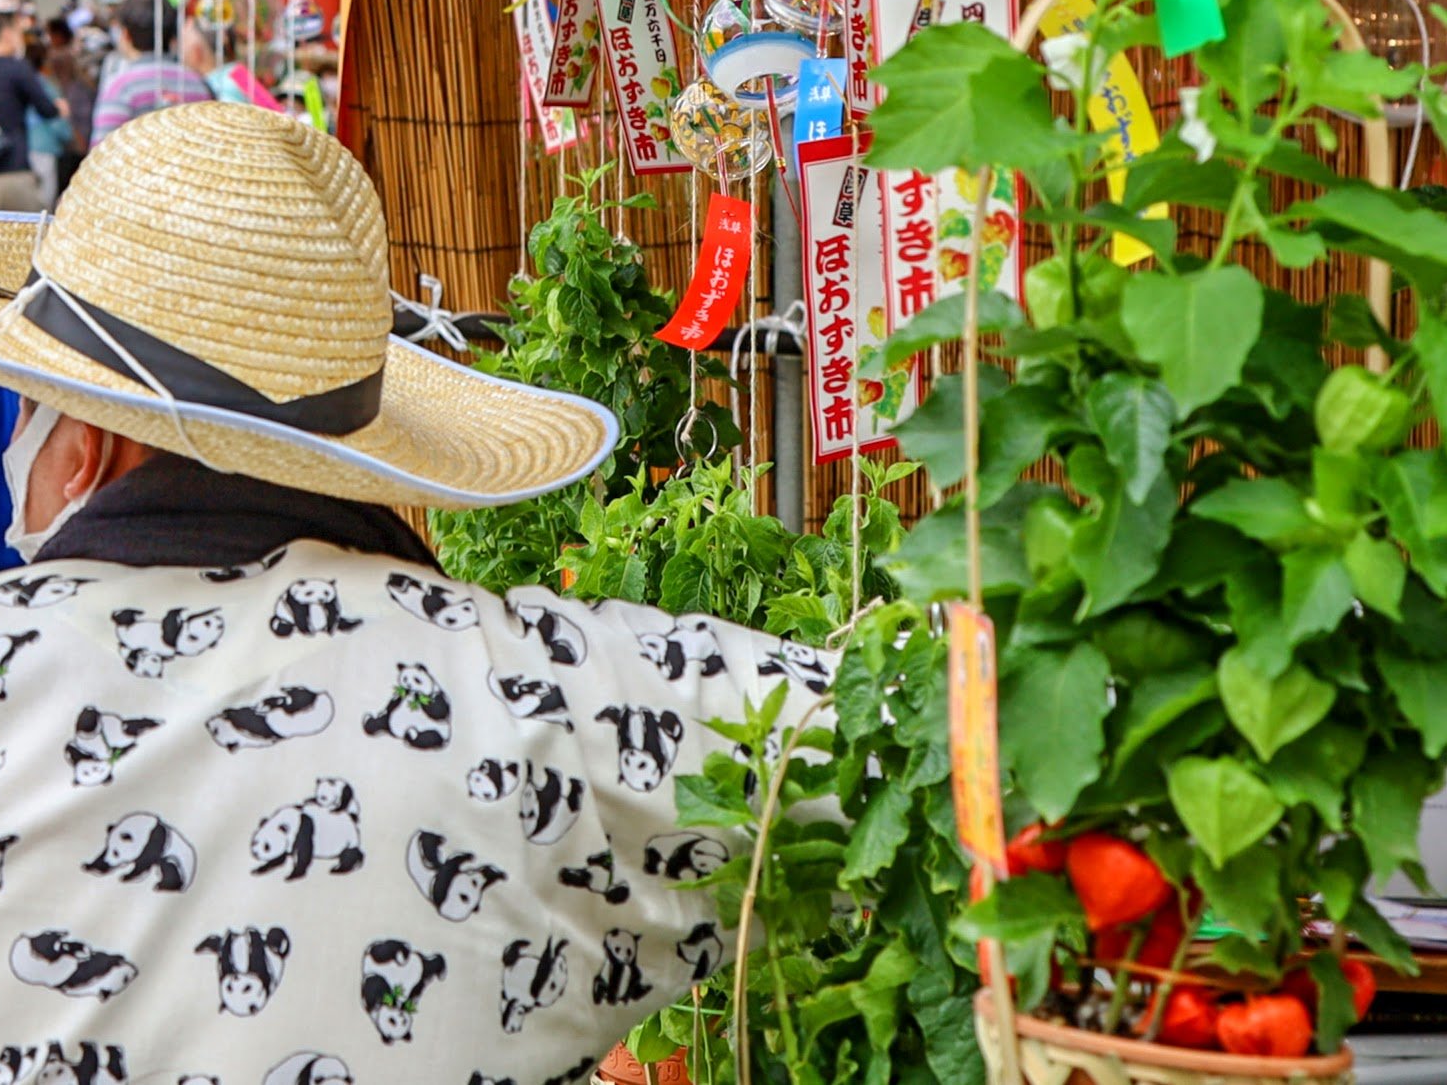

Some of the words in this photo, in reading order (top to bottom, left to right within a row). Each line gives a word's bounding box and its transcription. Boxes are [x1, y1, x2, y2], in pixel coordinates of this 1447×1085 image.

[609, 27, 658, 161] ほおずき市
[815, 234, 854, 441] ほおずき市
